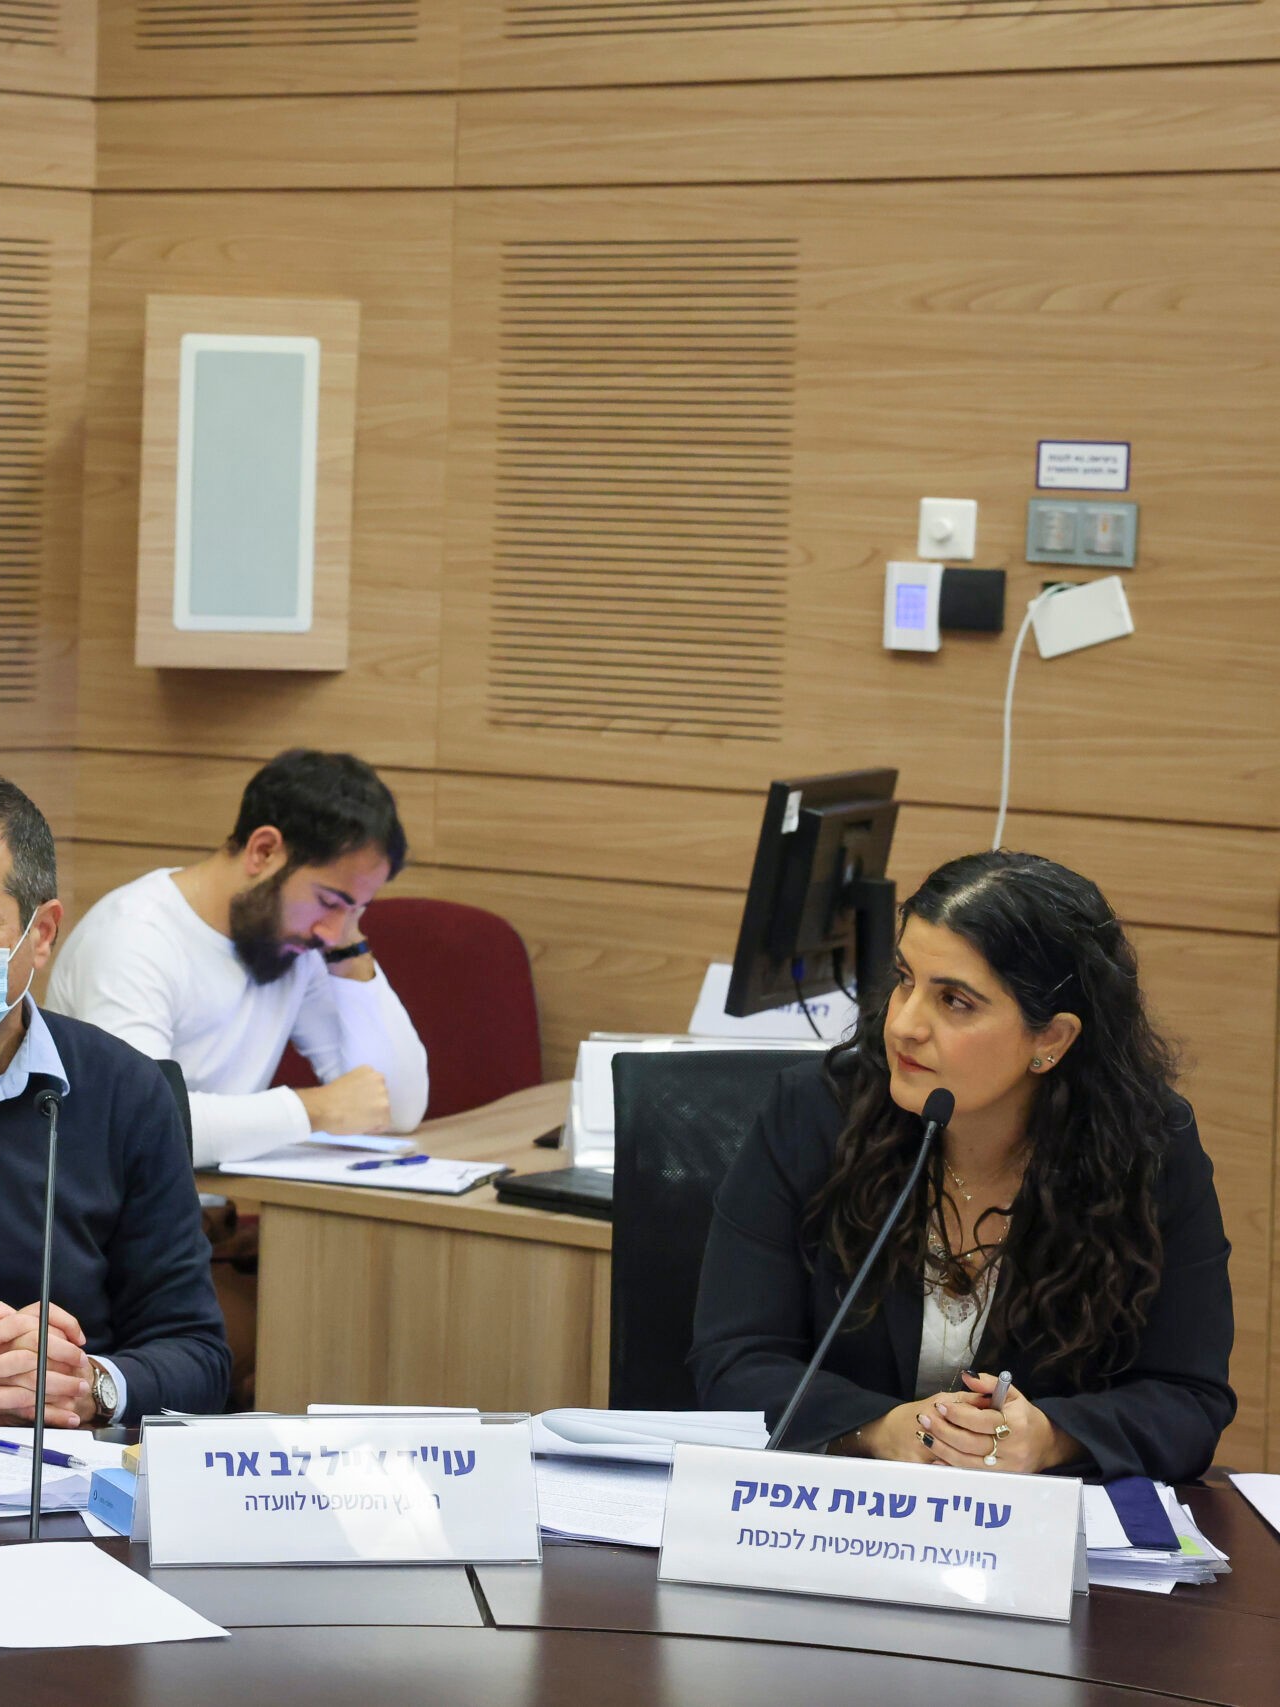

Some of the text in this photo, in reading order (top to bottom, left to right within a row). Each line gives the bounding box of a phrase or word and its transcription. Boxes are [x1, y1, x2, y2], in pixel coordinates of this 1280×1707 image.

[204, 1451, 261, 1477] ארי
[269, 1445, 312, 1477] לב
[245, 1491, 307, 1511] לוועדה
[311, 1494, 387, 1511] המשפטי
[731, 1480, 1012, 1529] עו"ד שגית אפיק
[736, 1527, 998, 1571] היועצת המשפטית לכנסת
